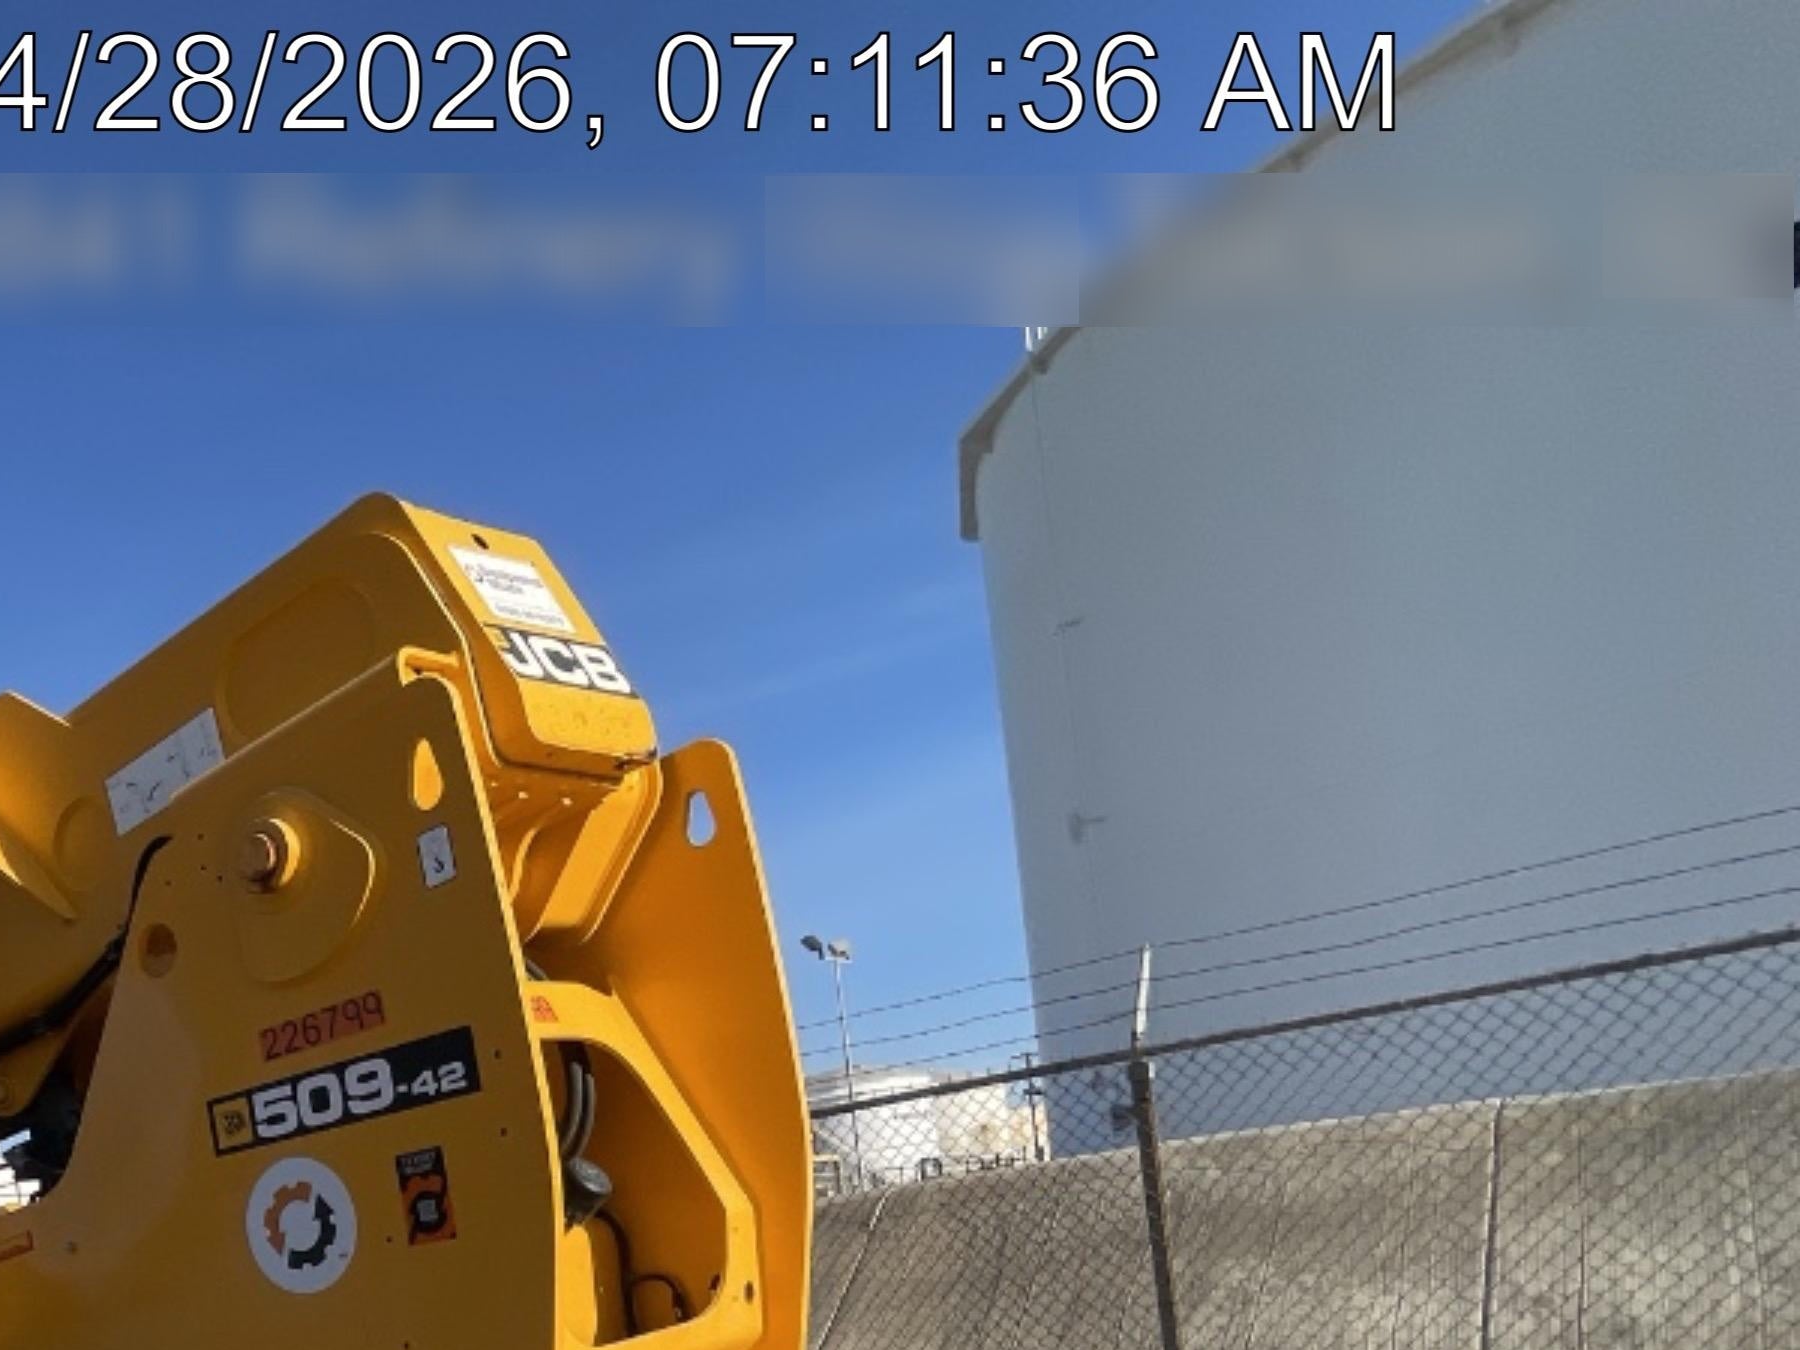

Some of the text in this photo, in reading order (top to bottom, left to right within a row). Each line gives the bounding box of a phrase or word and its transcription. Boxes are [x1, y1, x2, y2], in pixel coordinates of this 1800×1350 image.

[501, 629, 632, 694] JCB
[264, 991, 384, 1058] 226799
[253, 1057, 467, 1138] 509-42
